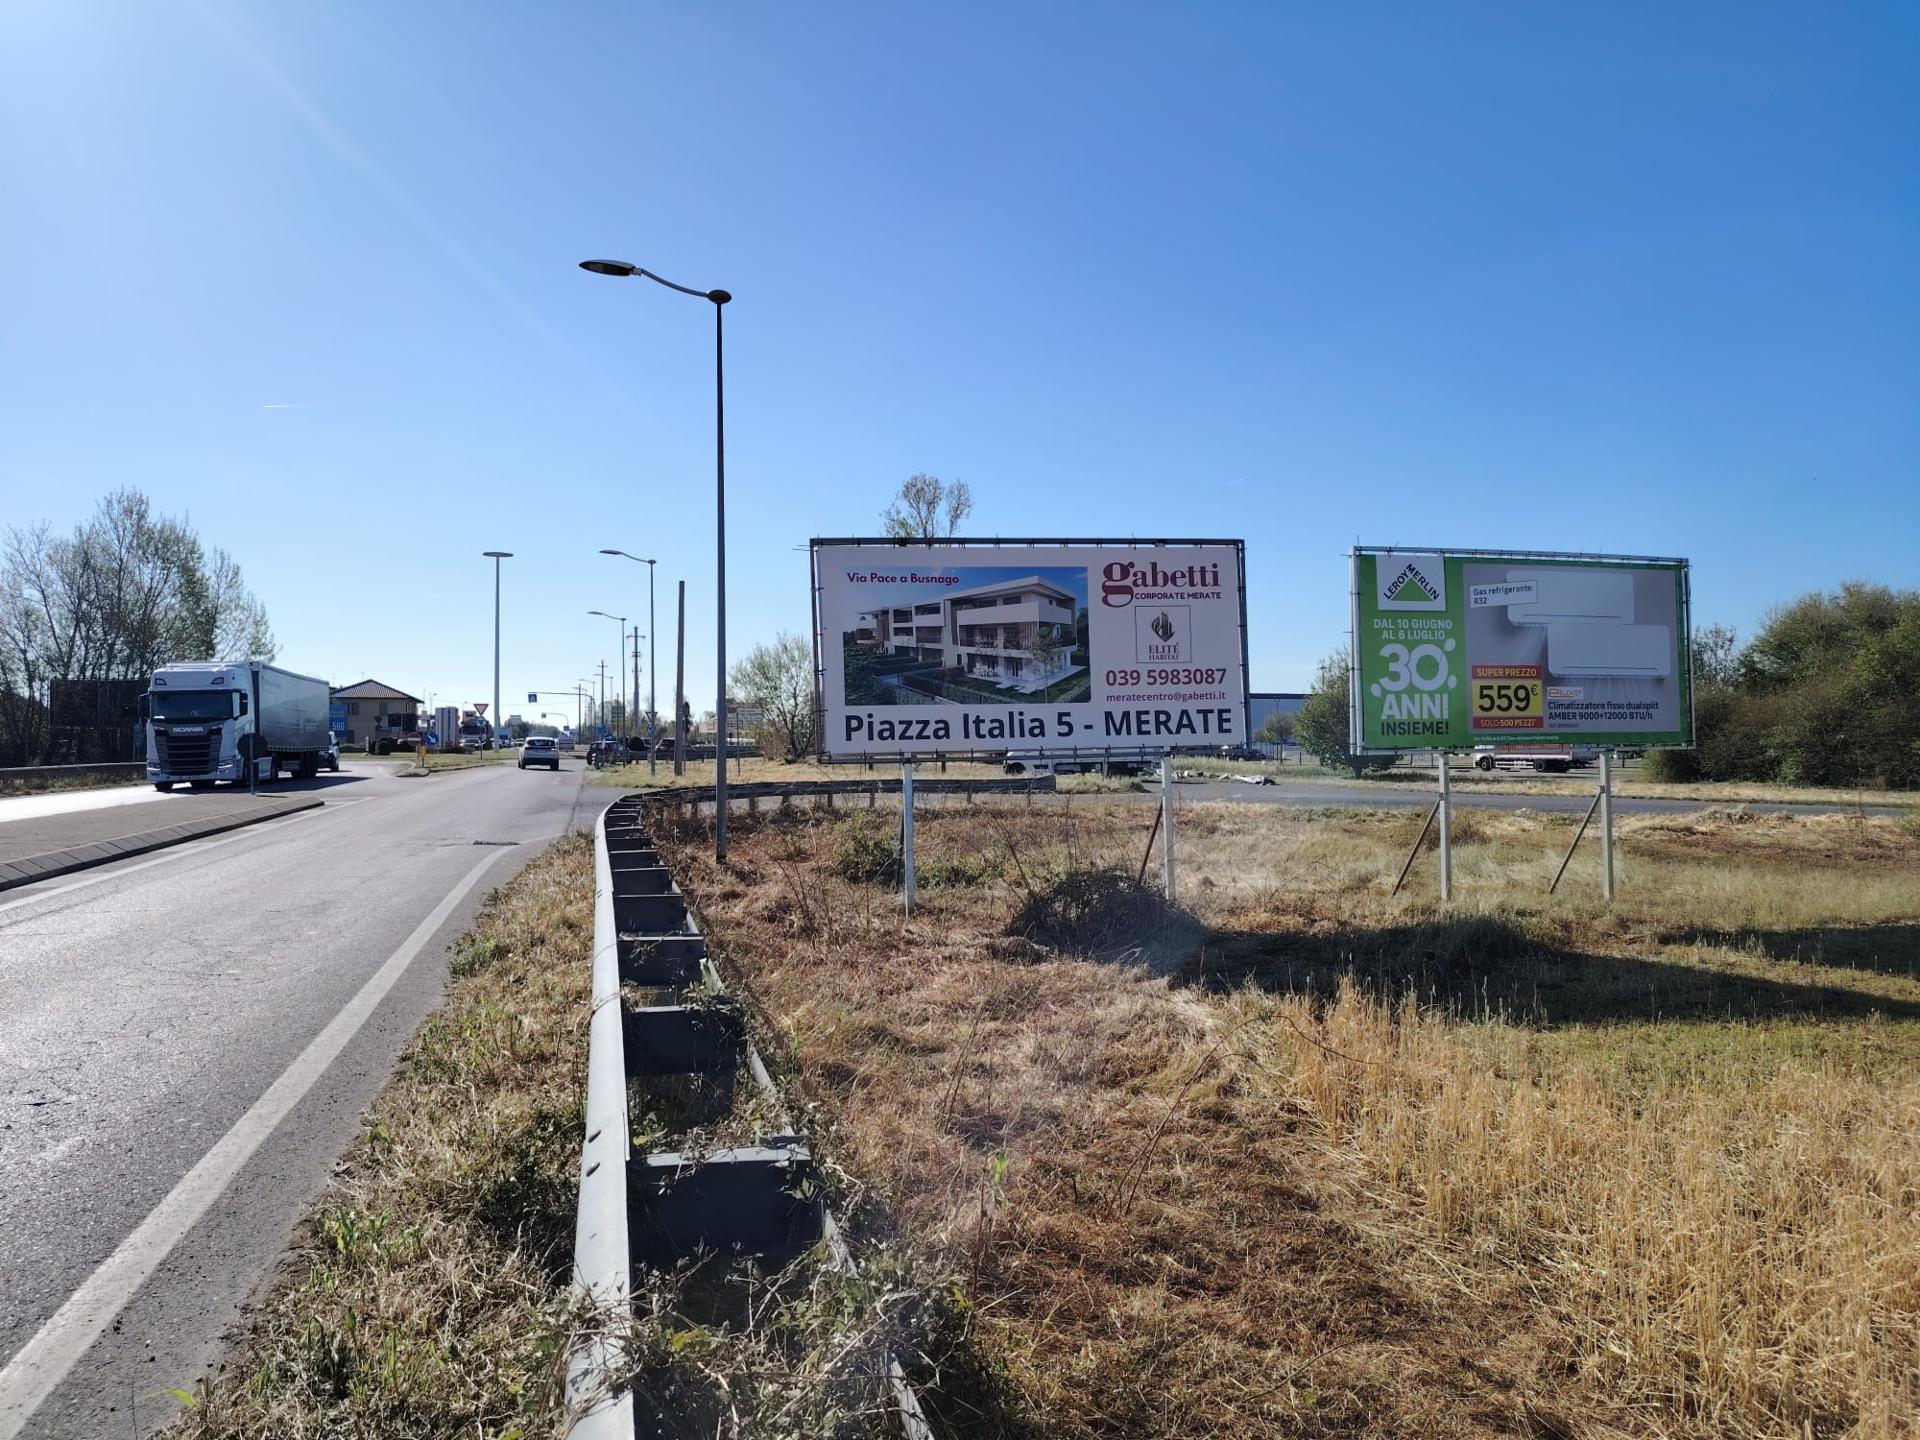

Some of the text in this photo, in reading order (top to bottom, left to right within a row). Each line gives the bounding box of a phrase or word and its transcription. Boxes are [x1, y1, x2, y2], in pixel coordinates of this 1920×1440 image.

[847, 572, 867, 583] Via
[870, 572, 897, 583] Pace
[910, 573, 959, 586] Busnago
[1102, 561, 1221, 608] gabetti
[1383, 569, 1409, 600] LEROY
[1406, 563, 1440, 600] MERLIN
[1134, 592, 1185, 600] CORPORATE
[1473, 587, 1487, 596] Gas
[1373, 619, 1453, 630] DAL 10 GIUGNO
[1381, 630, 1446, 641] AL 6 LUGLIO
[1148, 653, 1180, 661] HABITAT
[1379, 643, 1449, 692] 30
[1476, 668, 1537, 677] SUPER PREZZO
[1105, 668, 1227, 686] 039 5983087
[1106, 691, 1226, 702] meratecentro@gabetti.it
[1381, 693, 1449, 720] ANNI
[1548, 701, 1659, 711] Climatizzatore fisso dualsplit
[1548, 712, 1576, 720] AMBER
[1629, 711, 1653, 720] BTU/h
[845, 713, 950, 741] Piazza
[963, 711, 1046, 740] Italia
[1057, 711, 1074, 737] 5
[1104, 708, 1232, 736] MERATE
[1381, 721, 1449, 736] INSIEME!
[1480, 719, 1499, 727] SOLO
[1499, 719, 1513, 727] 500
